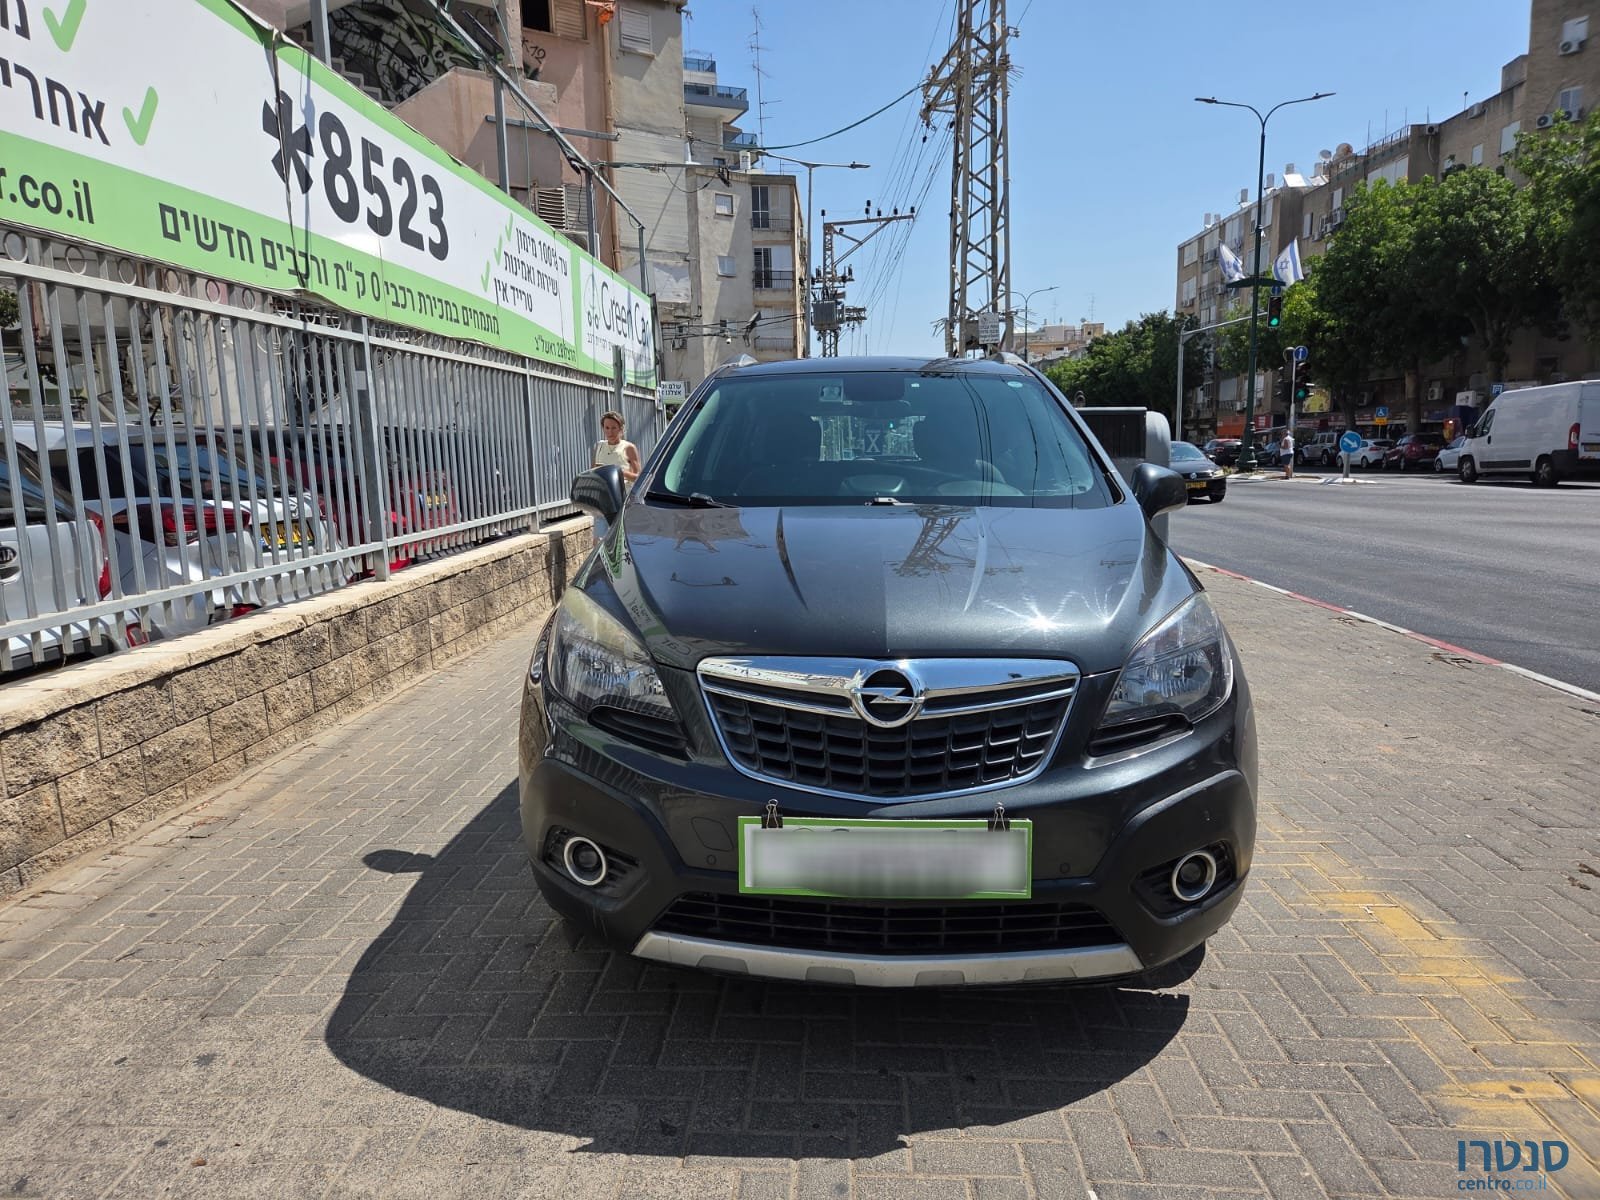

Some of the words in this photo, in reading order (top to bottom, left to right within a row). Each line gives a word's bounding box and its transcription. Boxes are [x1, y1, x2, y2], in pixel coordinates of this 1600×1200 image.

[158, 202, 255, 265] חדשים
[515, 227, 537, 259] מימון
[260, 237, 329, 287] ורכבים
[503, 250, 536, 286] ואמינות
[370, 271, 381, 302] 0
[383, 280, 416, 312] רכבי
[493, 277, 510, 306] אין
[509, 284, 533, 313] טרייד
[536, 269, 558, 297] שירות
[417, 290, 460, 325] במכירת
[462, 304, 500, 336] מתמחים
[601, 280, 634, 341] Green
